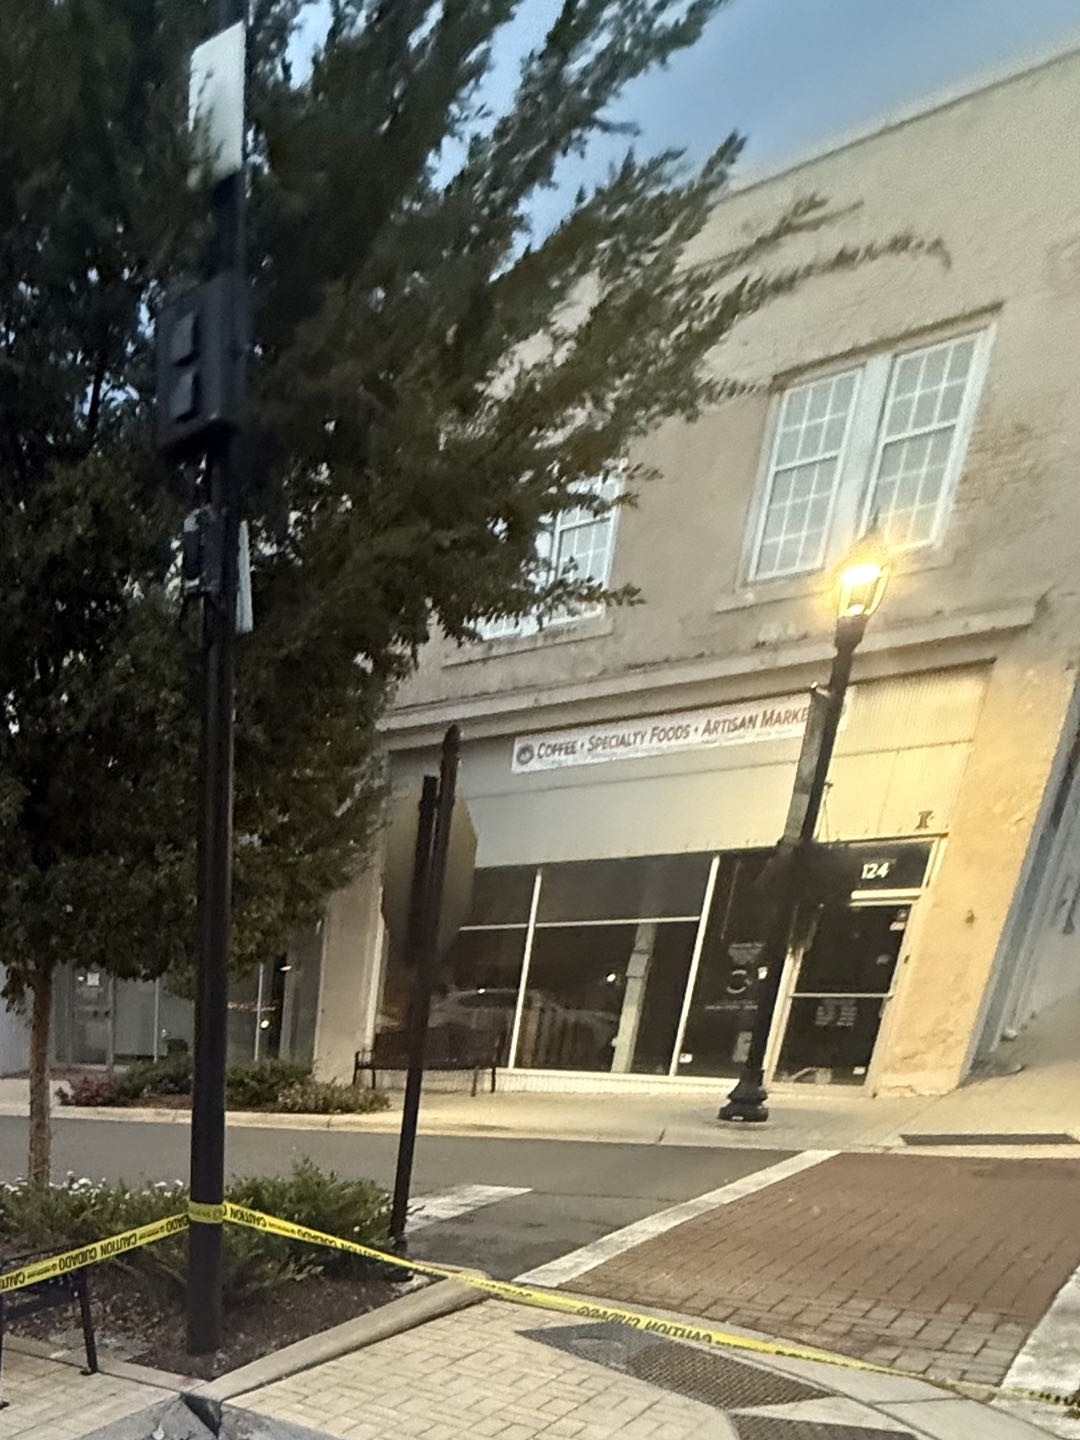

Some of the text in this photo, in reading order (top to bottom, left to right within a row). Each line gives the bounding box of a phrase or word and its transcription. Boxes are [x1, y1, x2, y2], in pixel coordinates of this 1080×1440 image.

[587, 731, 647, 751] SPECIALTY
[649, 724, 691, 744] FOODS
[701, 715, 759, 736] ARTISAN
[760, 707, 808, 728] MARKE
[861, 862, 889, 879] 124
[230, 1208, 267, 1228] CAUTION
[100, 1234, 137, 1255] CAUTION
[59, 1247, 98, 1270] CUIDADO
